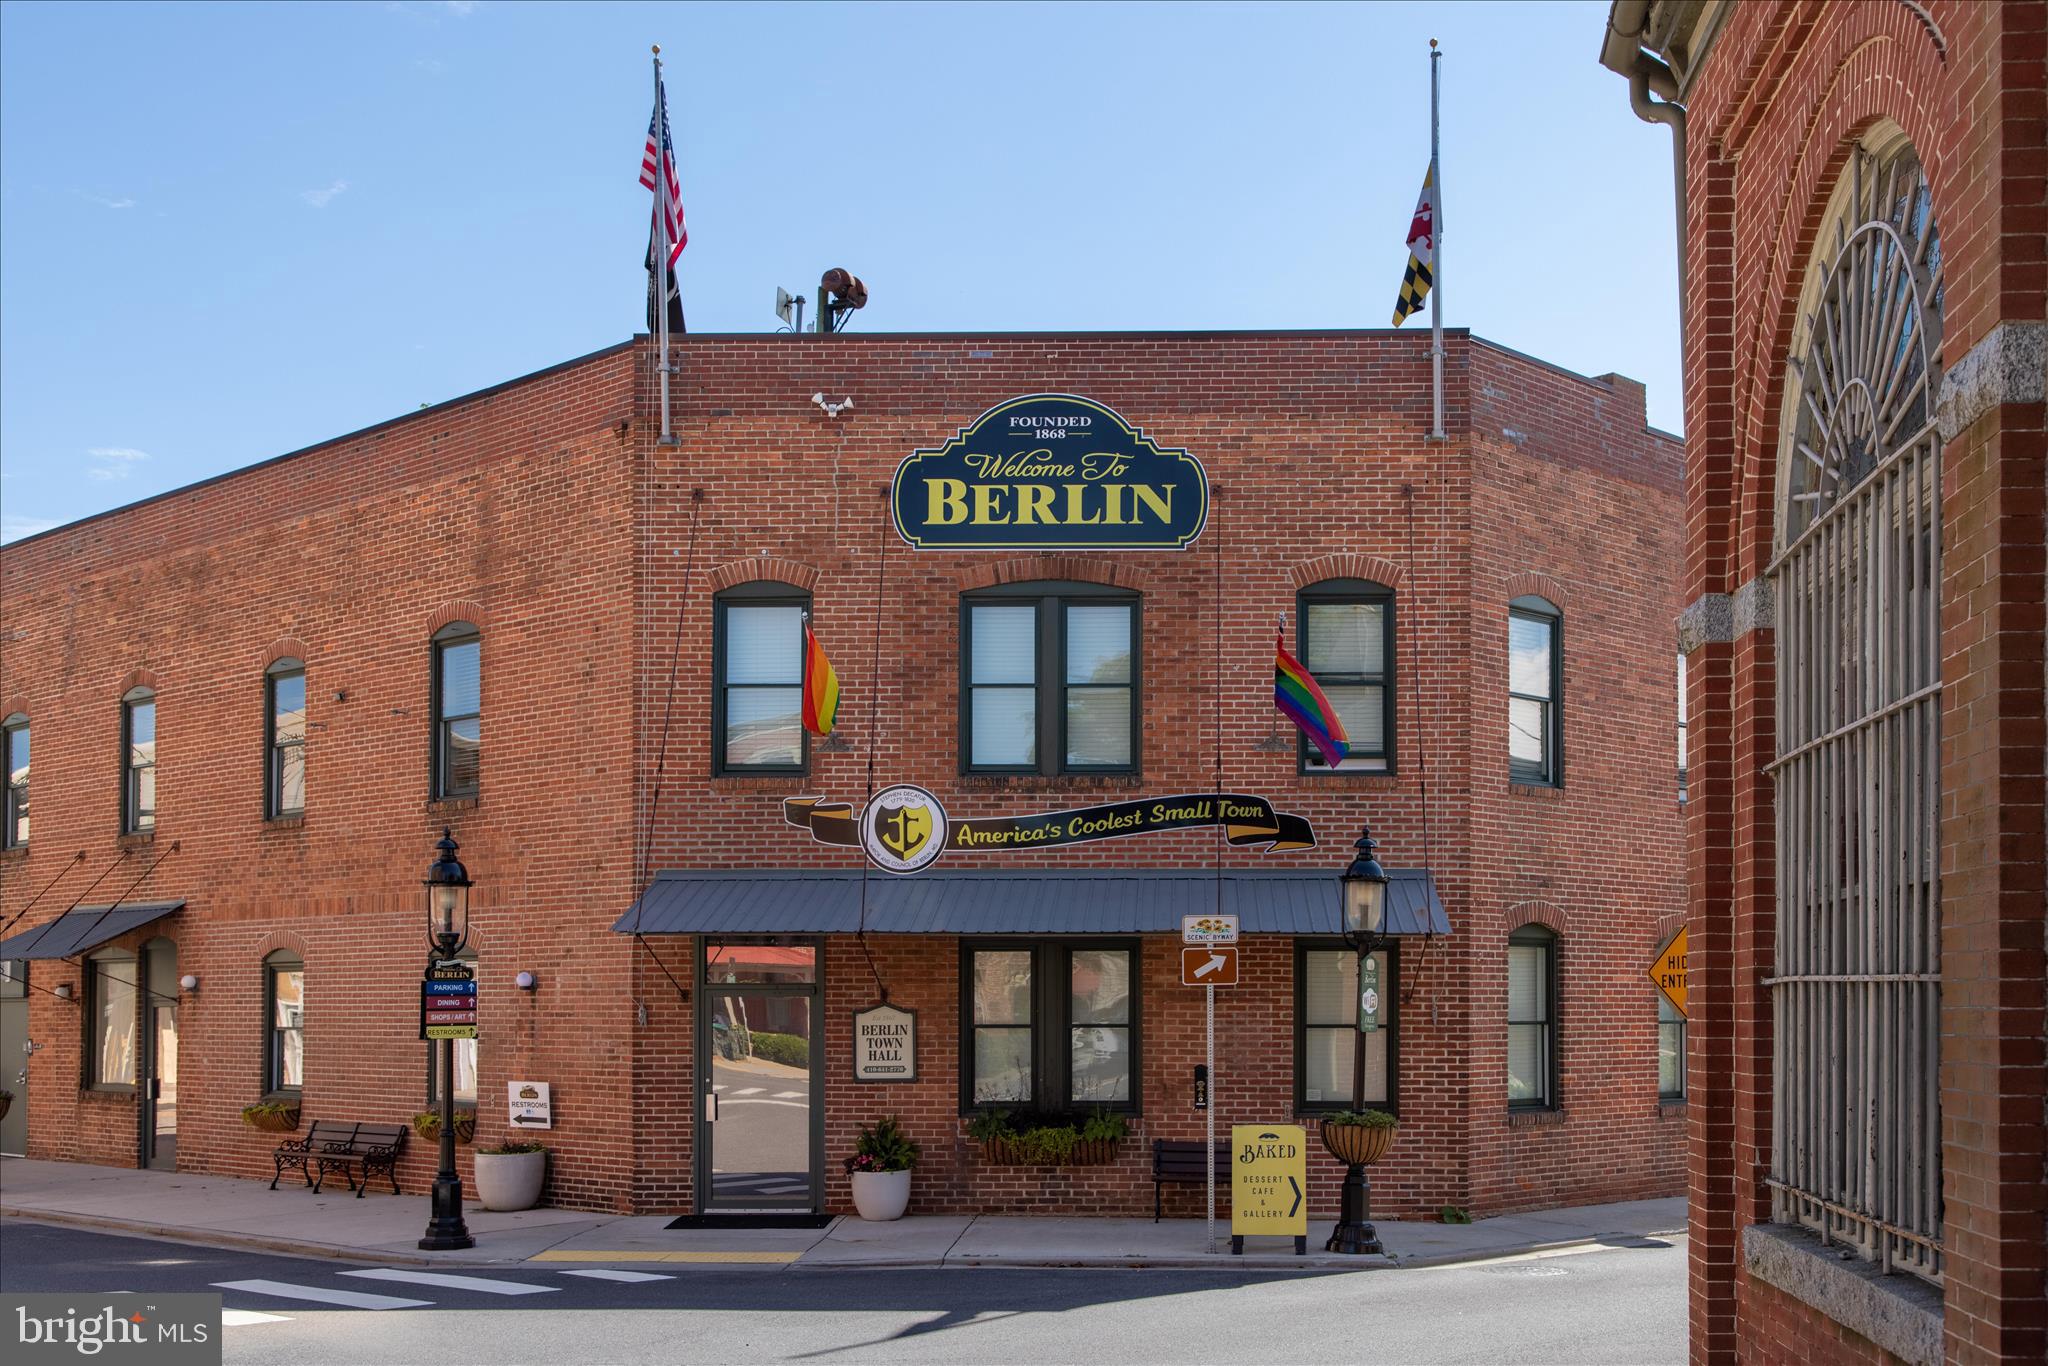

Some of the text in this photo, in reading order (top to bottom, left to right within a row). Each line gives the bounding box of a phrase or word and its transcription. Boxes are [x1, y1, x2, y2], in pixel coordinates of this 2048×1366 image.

[1009, 416, 1092, 427] FOUNDED
[1034, 429, 1066, 439] 1868
[964, 449, 1135, 480] Welcome To
[922, 478, 1177, 525] BERLIN
[957, 800, 1264, 846] America's Coolest Small Town
[861, 1024, 908, 1036] BERLIN
[866, 1037, 903, 1049] TOWN
[868, 1050, 902, 1061] HALL
[1240, 1144, 1296, 1164] BAKED
[1243, 1175, 1283, 1183] DESSERT
[1252, 1187, 1275, 1195] CAFE
[1243, 1210, 1284, 1218] GALLERY
